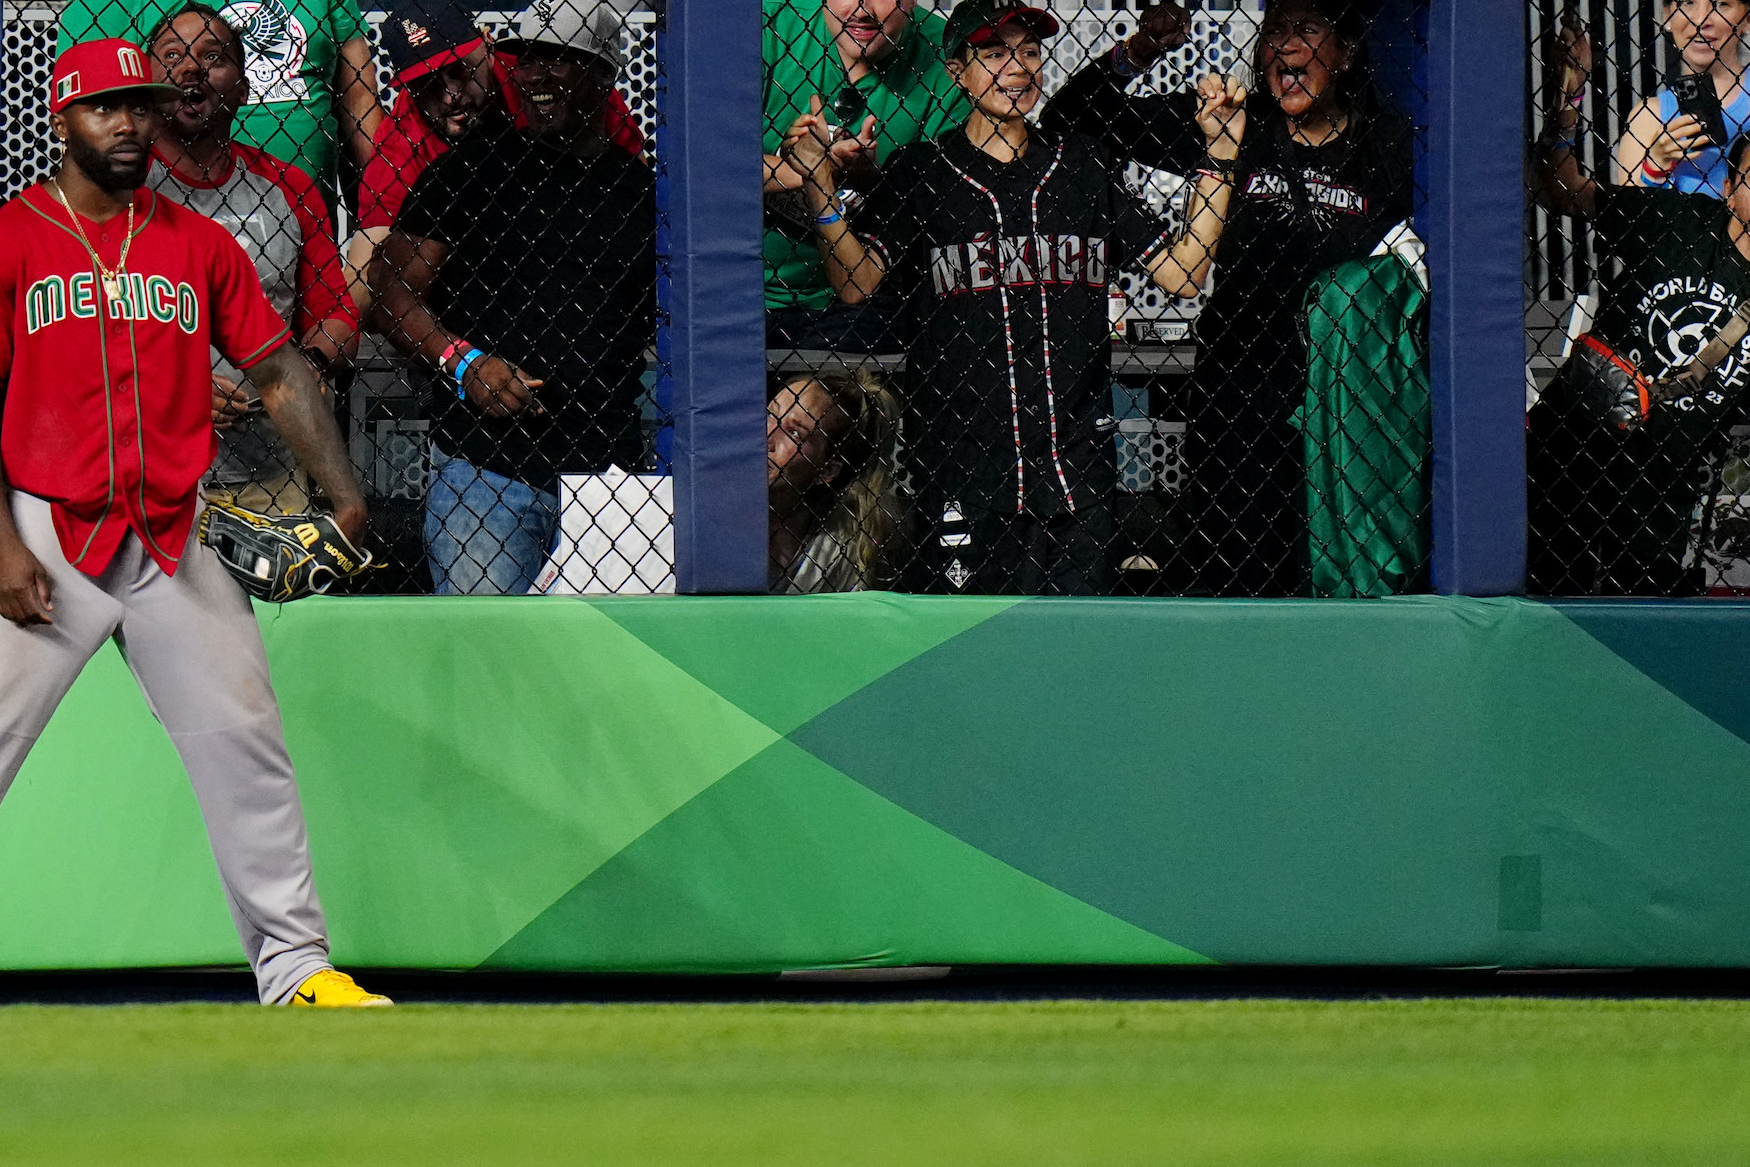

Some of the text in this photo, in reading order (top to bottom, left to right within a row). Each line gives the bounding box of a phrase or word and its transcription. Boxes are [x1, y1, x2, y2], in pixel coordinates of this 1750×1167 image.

[930, 231, 1107, 296] MÉXICO
[26, 272, 199, 334] MEXICO
[1636, 276, 1708, 314] WORLD
